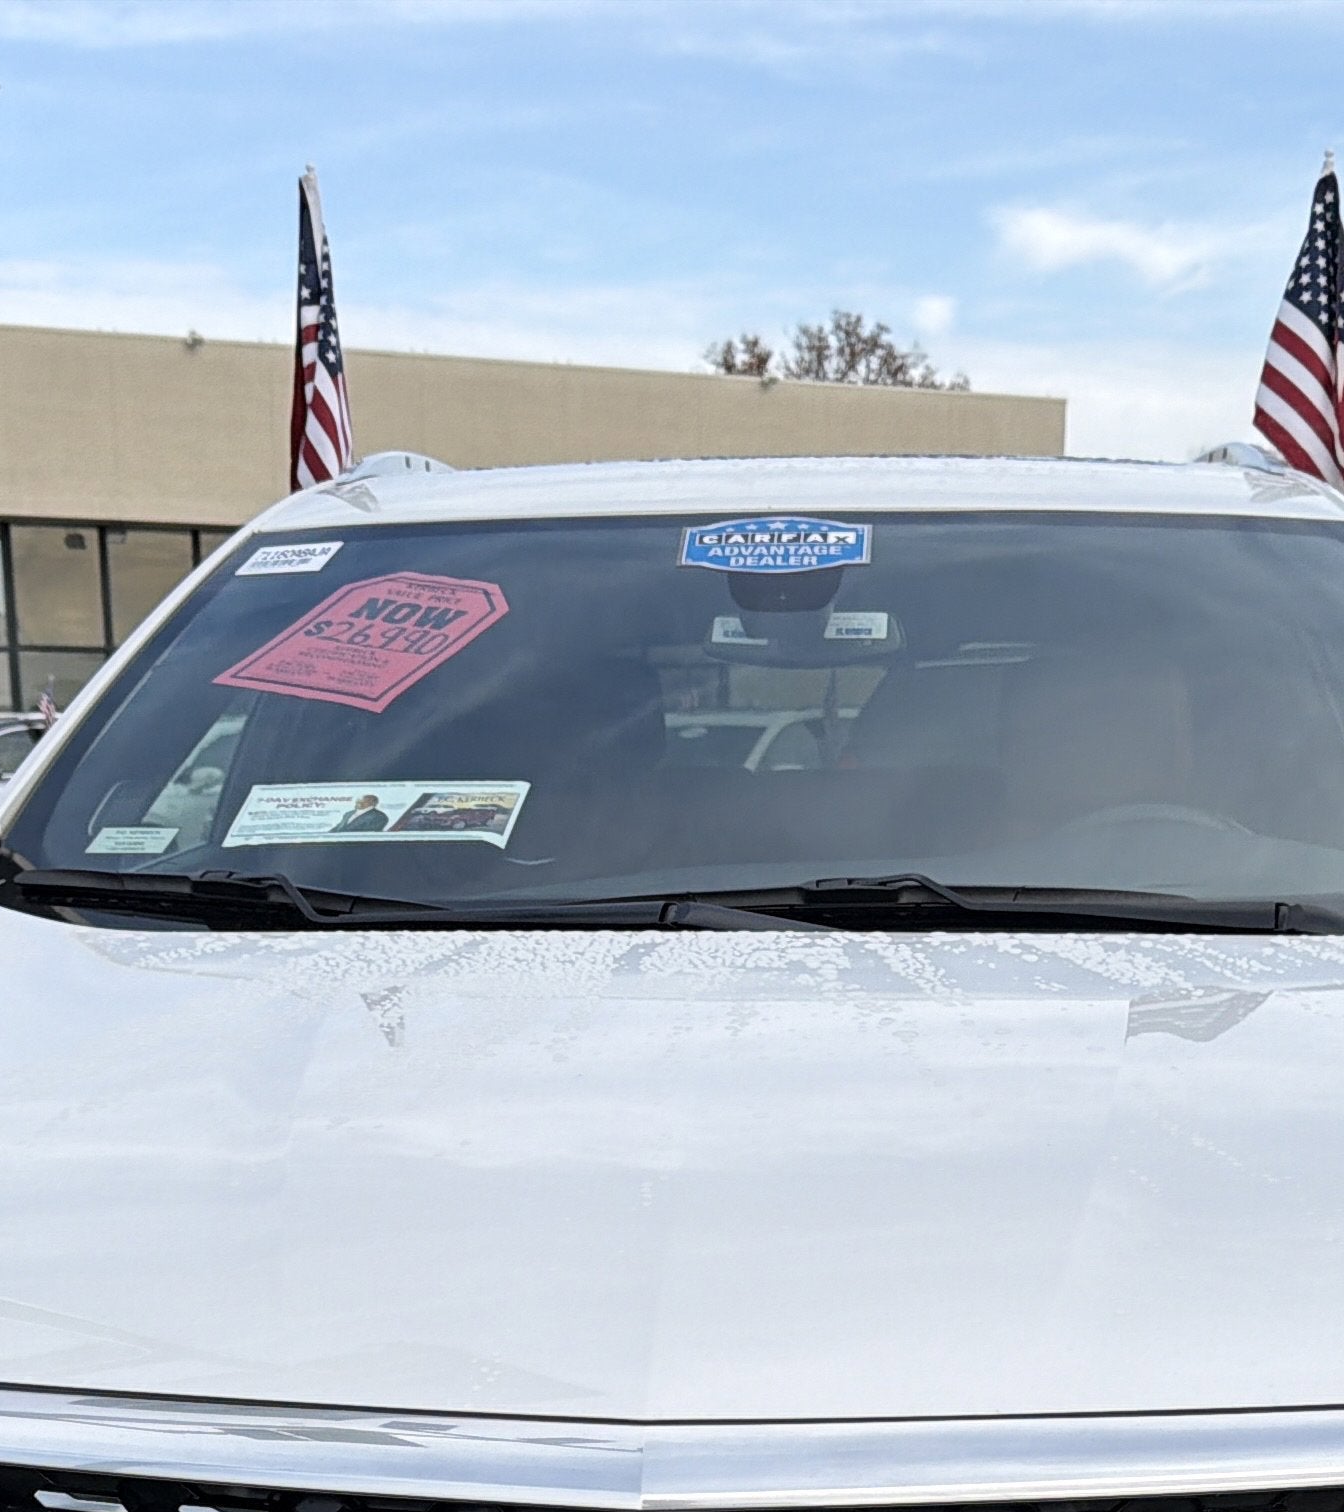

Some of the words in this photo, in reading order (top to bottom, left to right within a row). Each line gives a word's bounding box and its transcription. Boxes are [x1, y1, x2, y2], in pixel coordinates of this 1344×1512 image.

[701, 532, 854, 545] CARFAX
[708, 546, 842, 556] ADVANTAGE
[729, 555, 819, 567] DEALER
[348, 597, 468, 630] NOW
